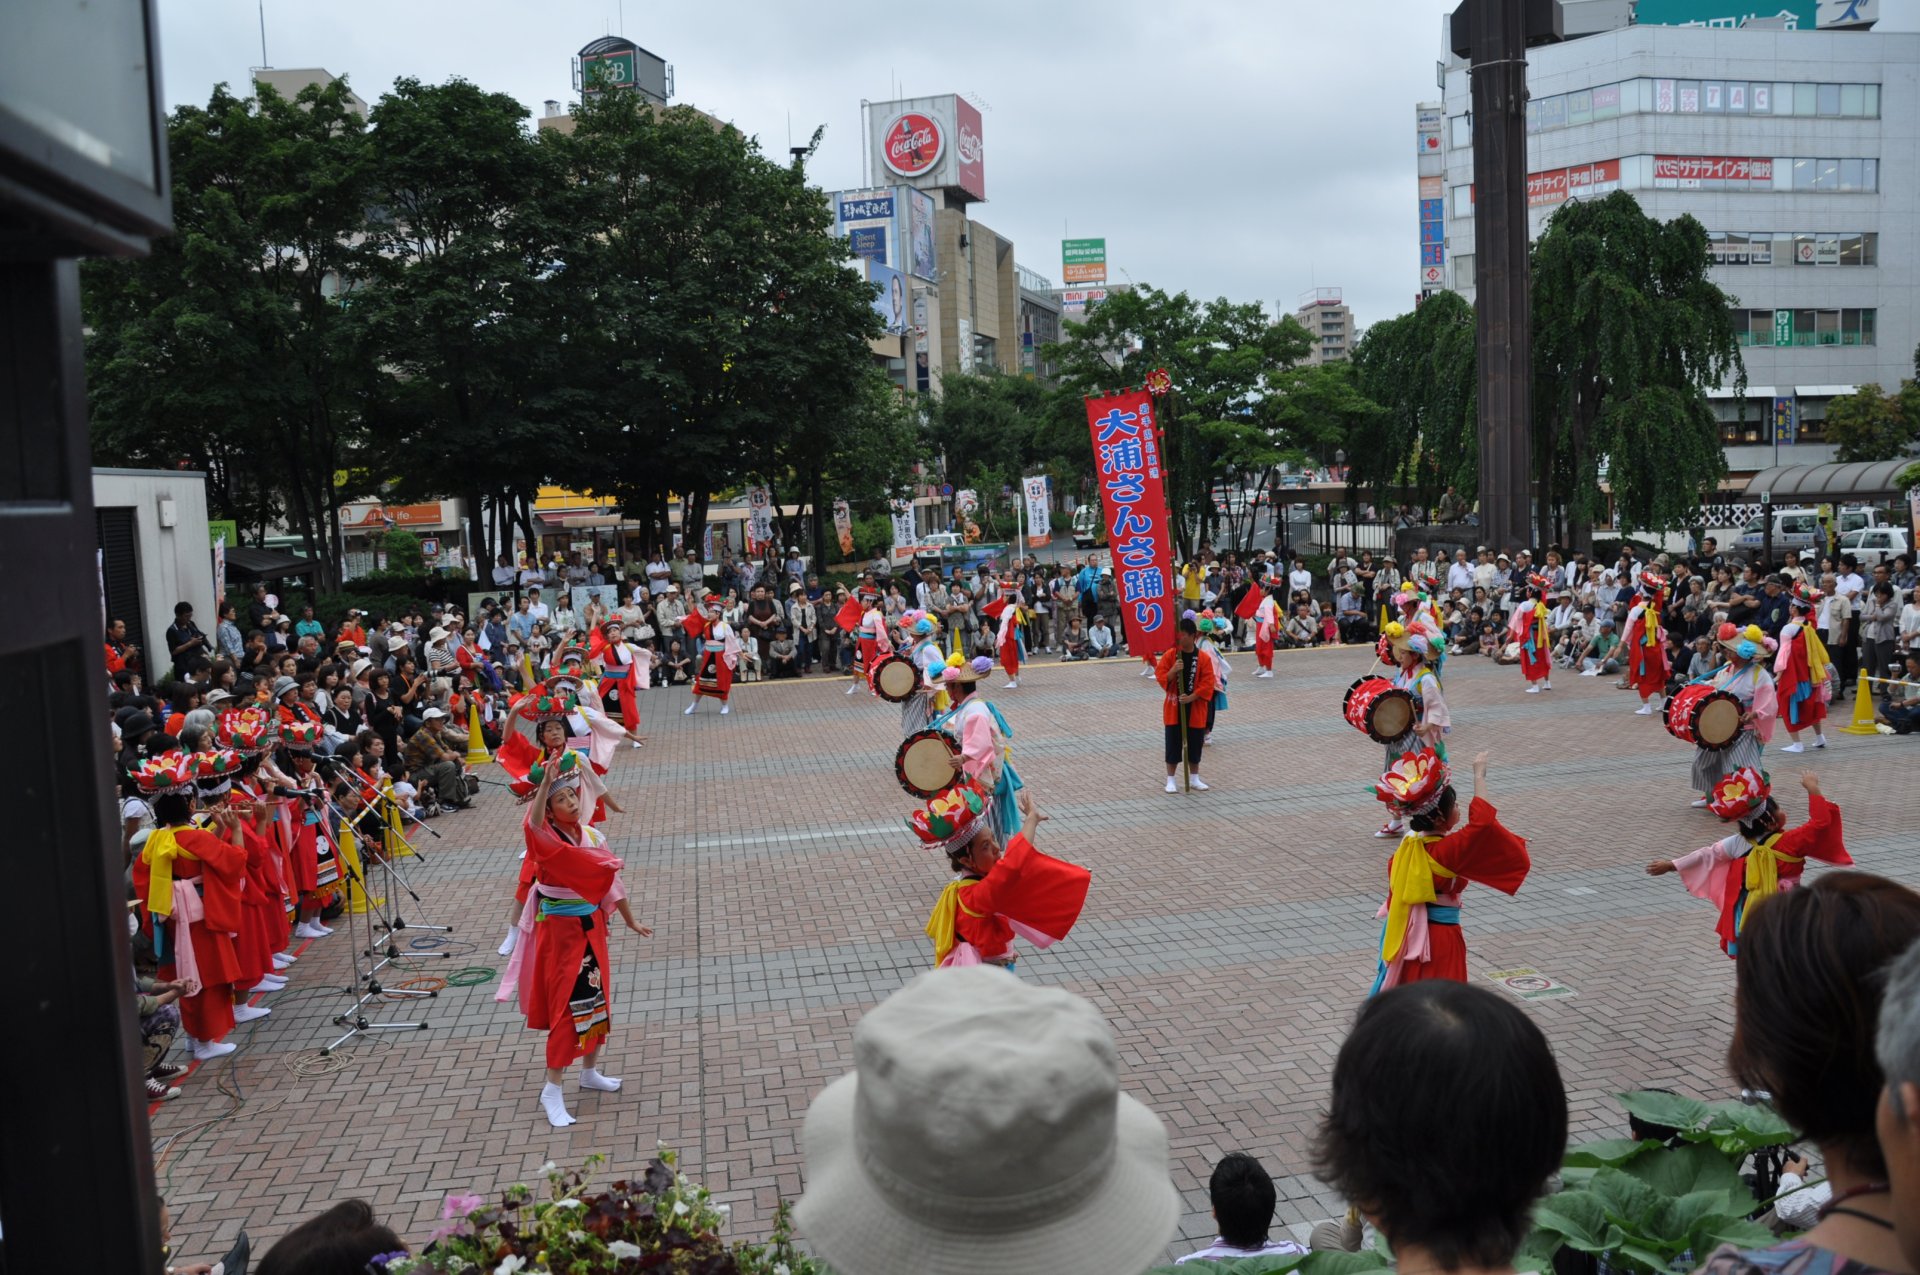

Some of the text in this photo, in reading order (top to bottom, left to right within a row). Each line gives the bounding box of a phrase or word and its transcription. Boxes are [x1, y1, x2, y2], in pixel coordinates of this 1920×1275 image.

[1095, 407, 1165, 632] 大浦さんさ踊り
